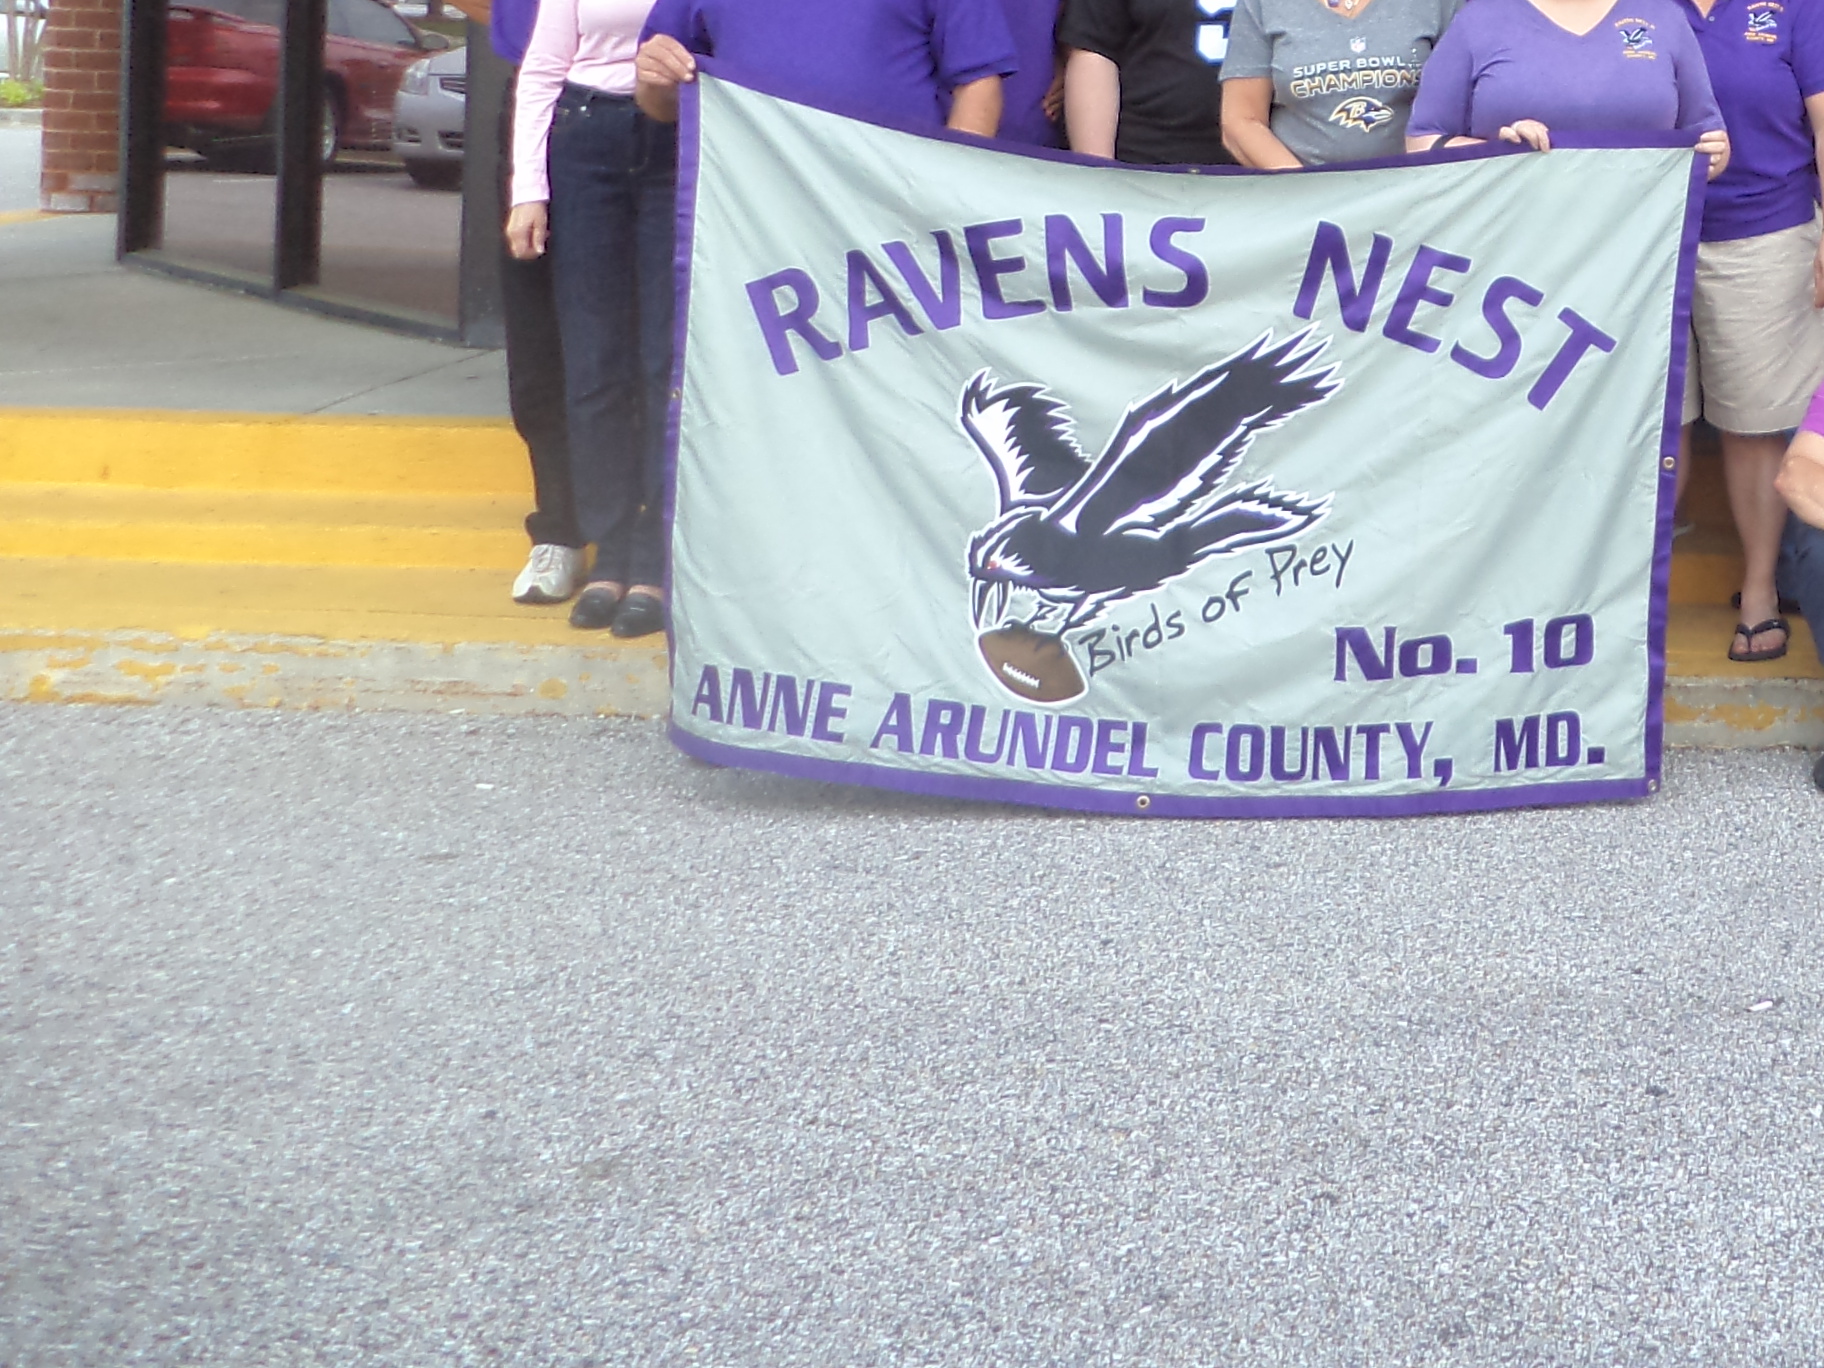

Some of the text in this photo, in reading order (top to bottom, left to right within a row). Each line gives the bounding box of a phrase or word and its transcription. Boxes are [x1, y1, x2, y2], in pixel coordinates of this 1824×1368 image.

[1293, 55, 1406, 78] SUPER BOWL
[745, 212, 1618, 412] RAVENS NEST
[1078, 539, 1354, 678] Birds of Prey
[1334, 613, 1595, 682] No. 10
[691, 664, 1606, 787] ANNE ARUNDEL COUNTY, MD.
